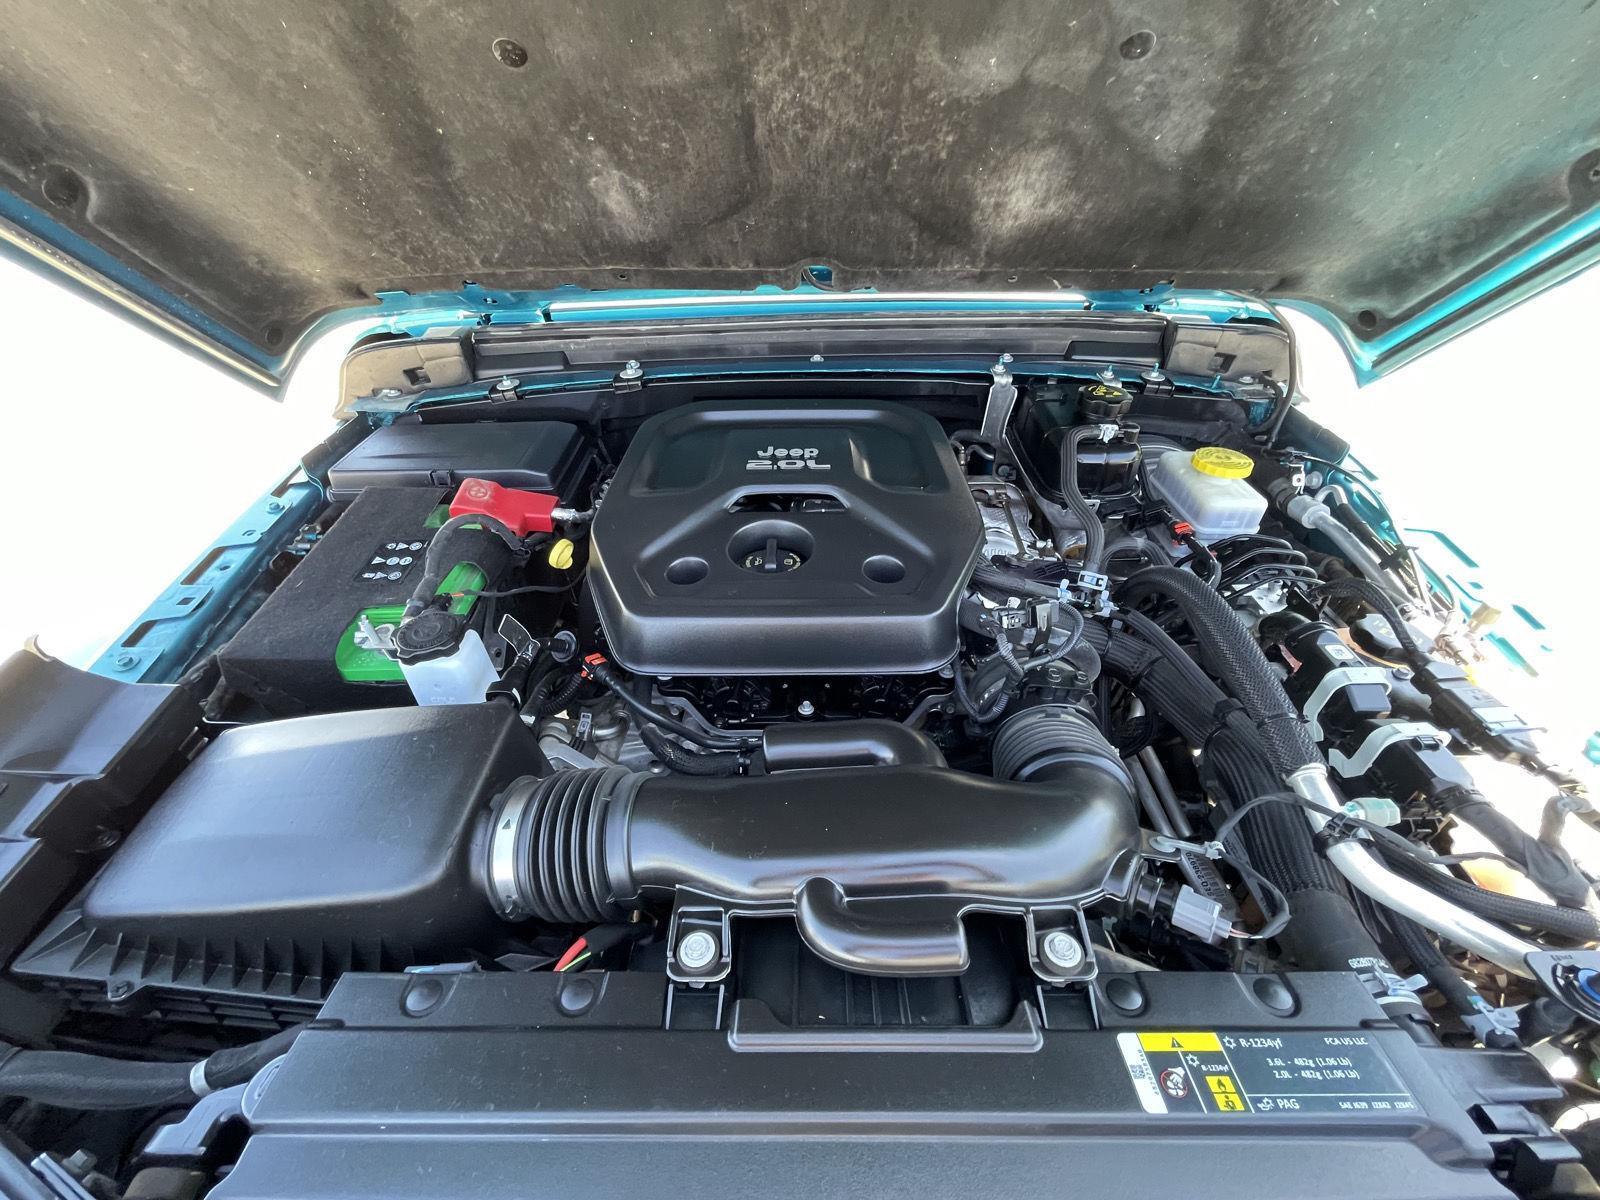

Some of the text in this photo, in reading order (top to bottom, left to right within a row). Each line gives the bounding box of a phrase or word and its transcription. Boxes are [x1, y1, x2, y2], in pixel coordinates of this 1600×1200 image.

[757, 446, 819, 459] Jeep
[746, 460, 831, 470] 2.0L
[1239, 1037, 1283, 1049] R-1234yf
[1324, 1037, 1368, 1045] FCA US LLC
[1266, 1058, 1286, 1066] 3.6L
[1273, 1070, 1293, 1079] 2.0L
[1276, 1098, 1300, 1110] PAG
